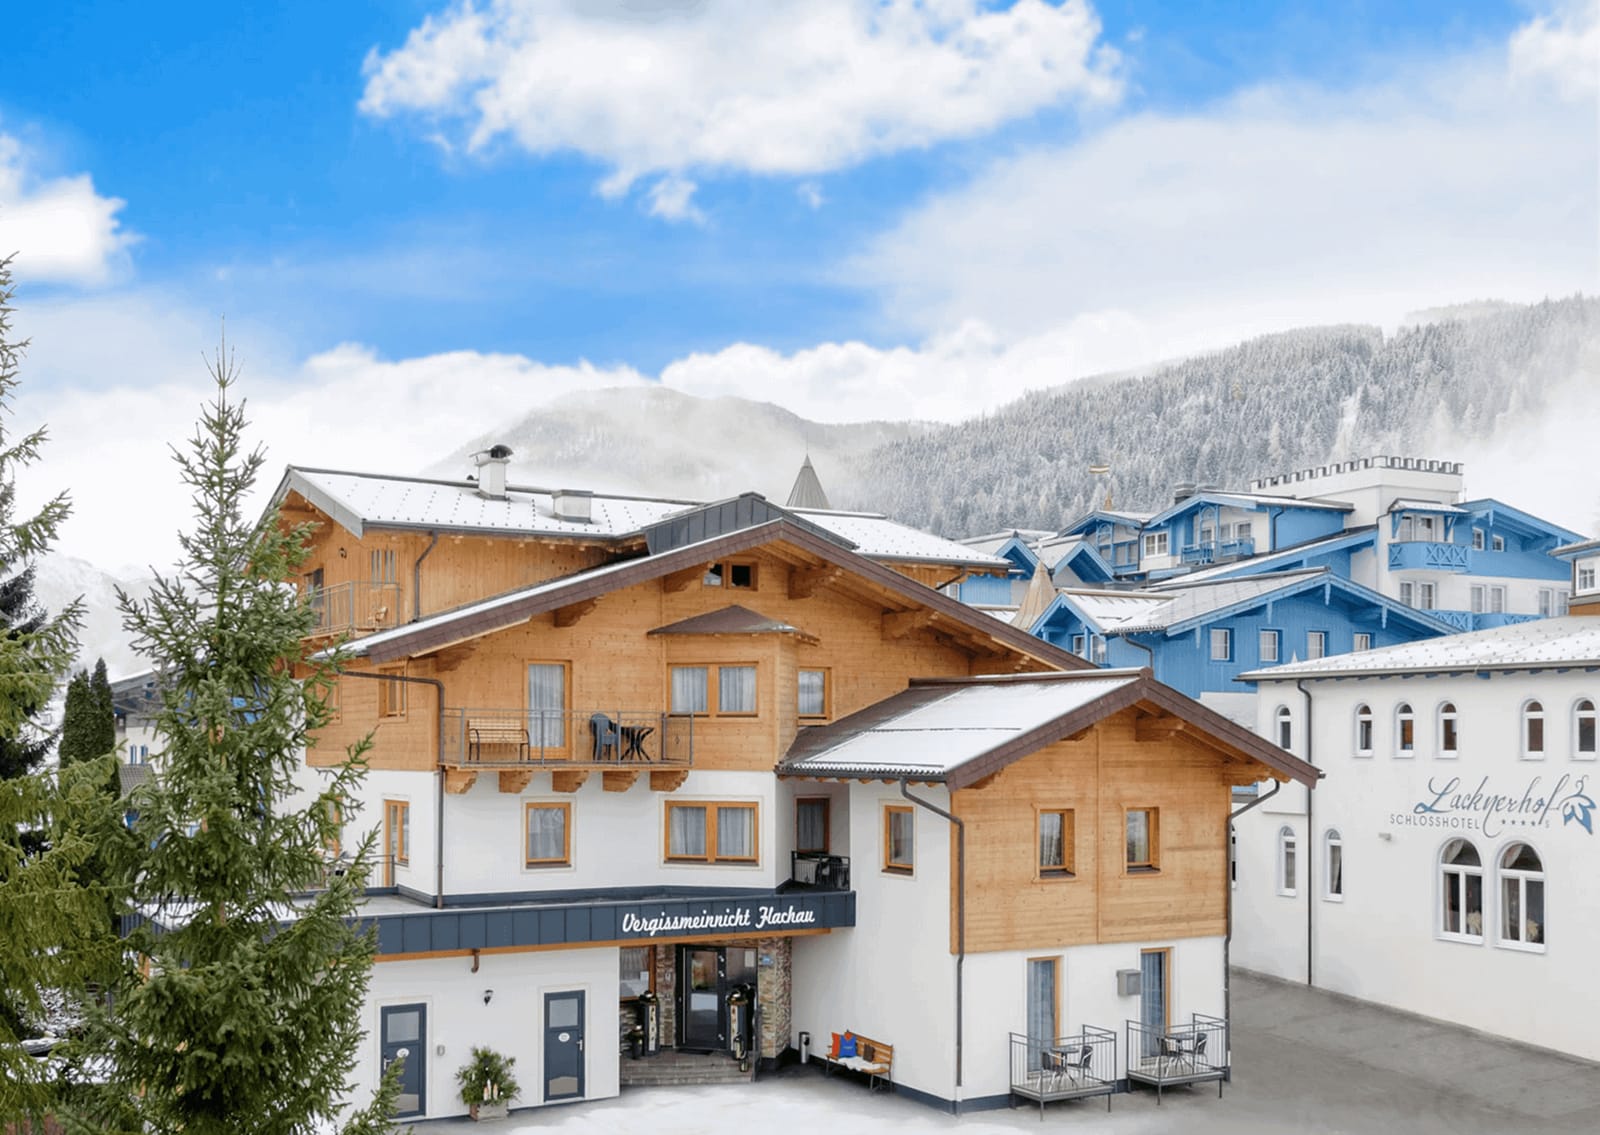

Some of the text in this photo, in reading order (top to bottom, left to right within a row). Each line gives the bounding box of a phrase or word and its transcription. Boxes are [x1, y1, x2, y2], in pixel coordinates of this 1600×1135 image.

[1413, 773, 1570, 838] Lacknerhof
[1389, 814, 1480, 830] SCHLOSSHOTEL
[622, 905, 815, 936] Vergissmeinnicht Flachau
